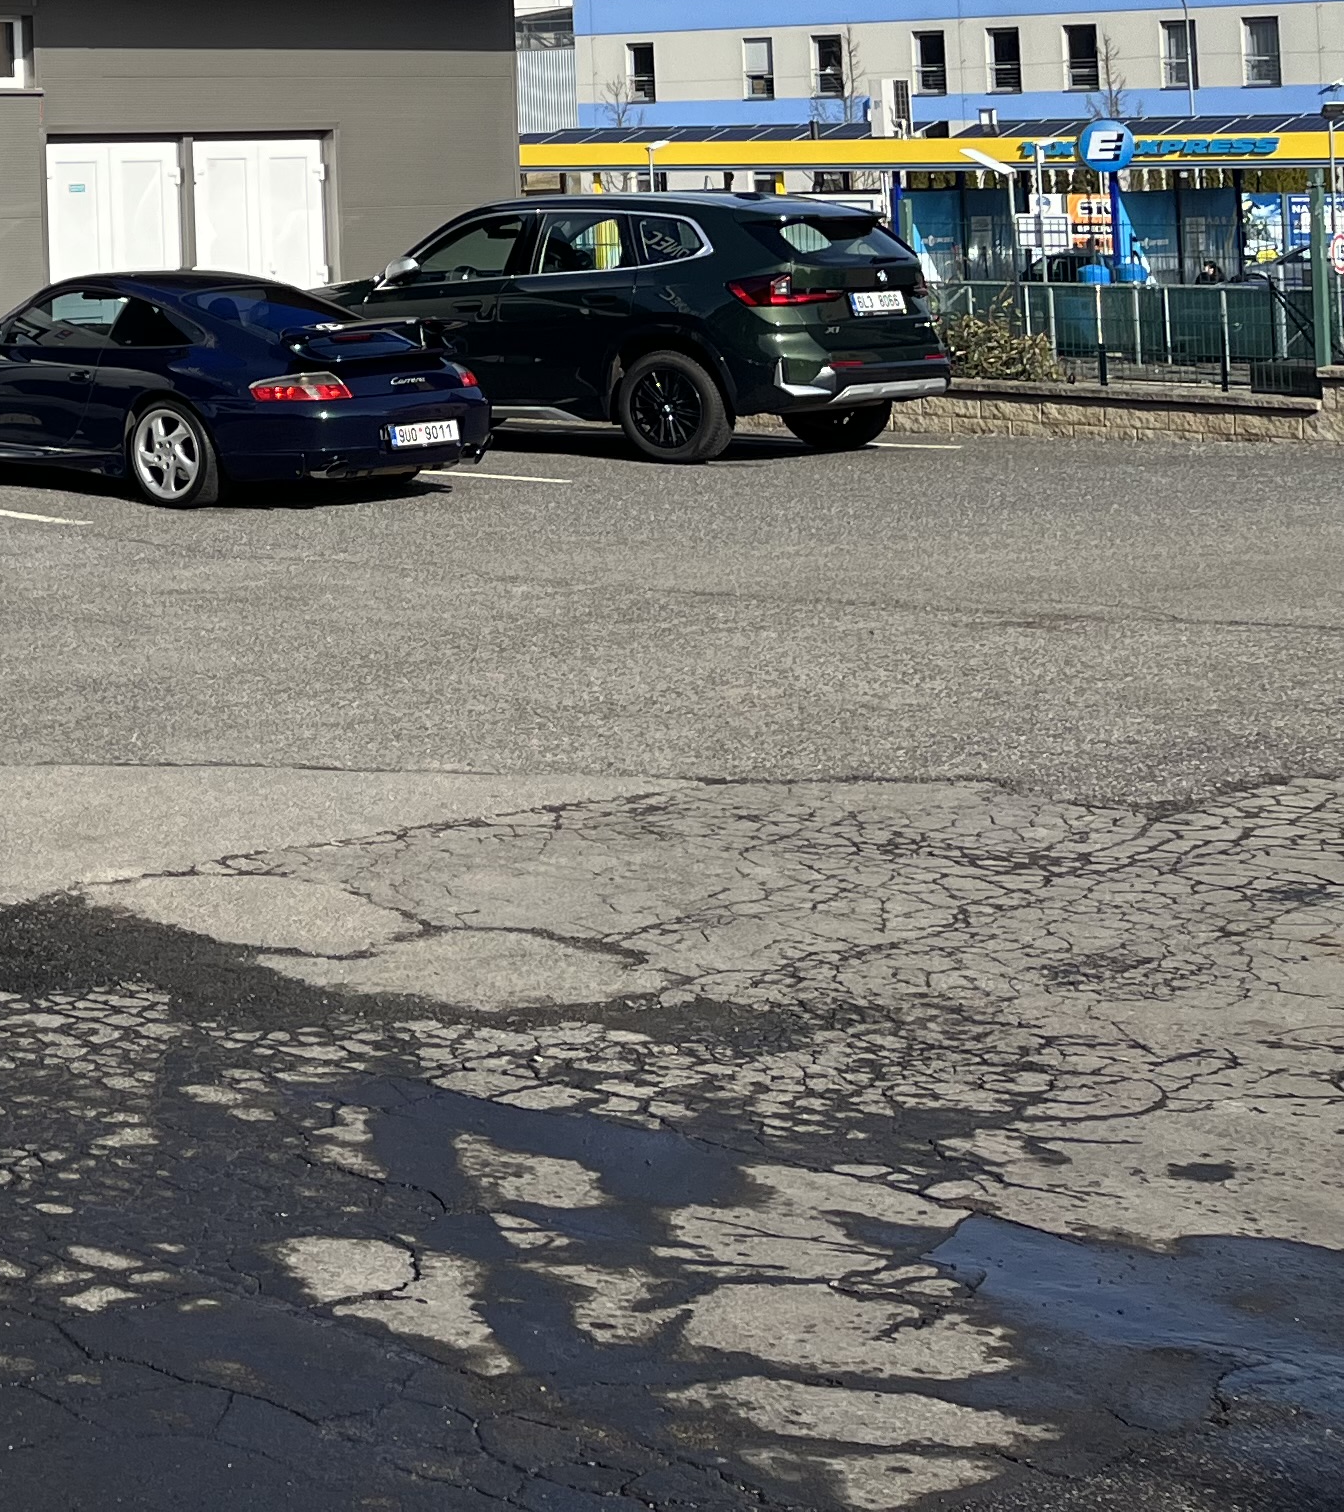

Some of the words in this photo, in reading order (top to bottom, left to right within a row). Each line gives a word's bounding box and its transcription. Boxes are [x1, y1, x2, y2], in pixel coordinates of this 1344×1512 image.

[391, 377, 426, 385] Carrera
[399, 428, 417, 443] 9U0
[425, 424, 452, 440] 9011
